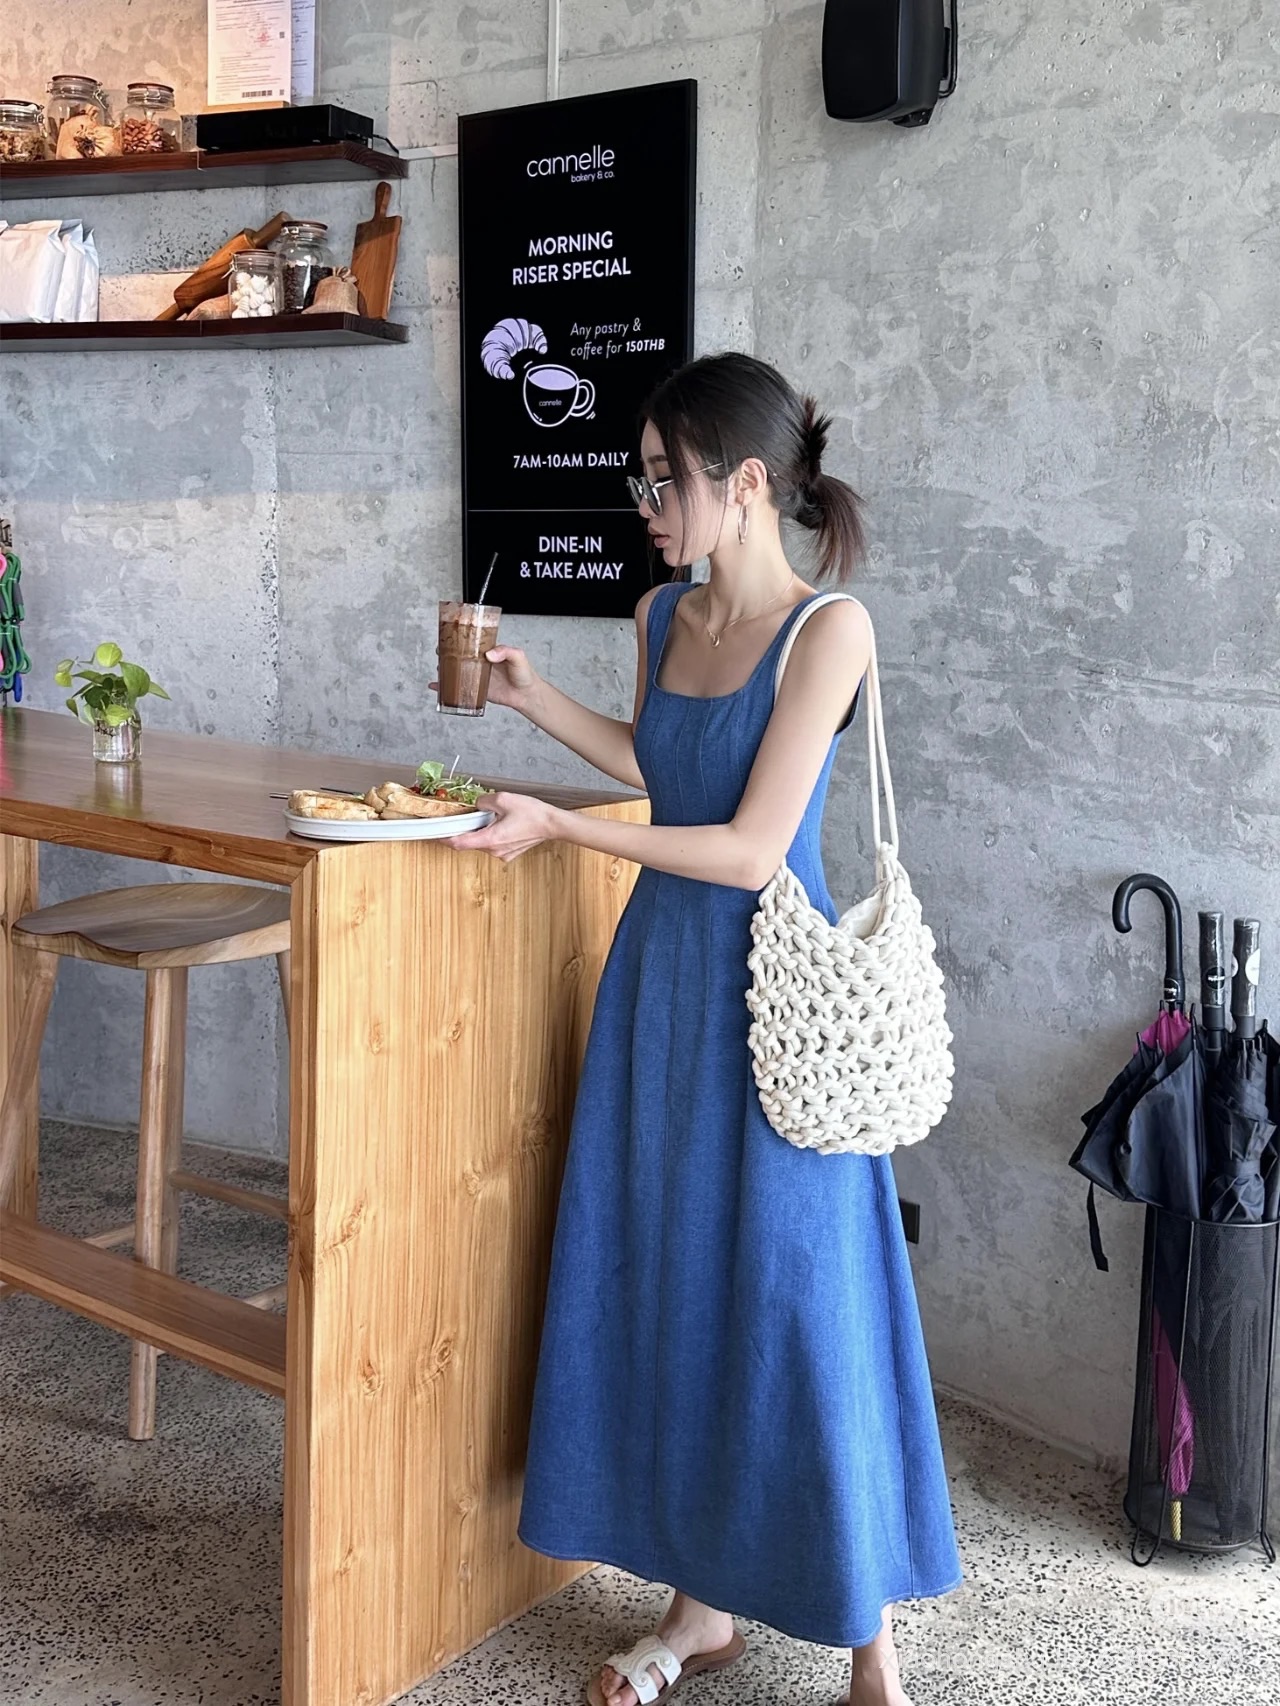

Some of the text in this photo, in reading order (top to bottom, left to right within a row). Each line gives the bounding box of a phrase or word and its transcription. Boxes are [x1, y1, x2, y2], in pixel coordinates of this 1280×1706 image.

[526, 144, 615, 178] cannelle
[570, 168, 615, 183] bakery & co.
[528, 230, 614, 257] MORNING
[512, 257, 632, 286] RISER SPECIAL
[570, 317, 642, 341] Any pastry &
[570, 338, 666, 360] coffee for 150THB
[513, 451, 630, 469] 7AM-10AM DAILY
[538, 535, 603, 554] DINE-IN
[519, 561, 624, 580] & TAKE AWAY
